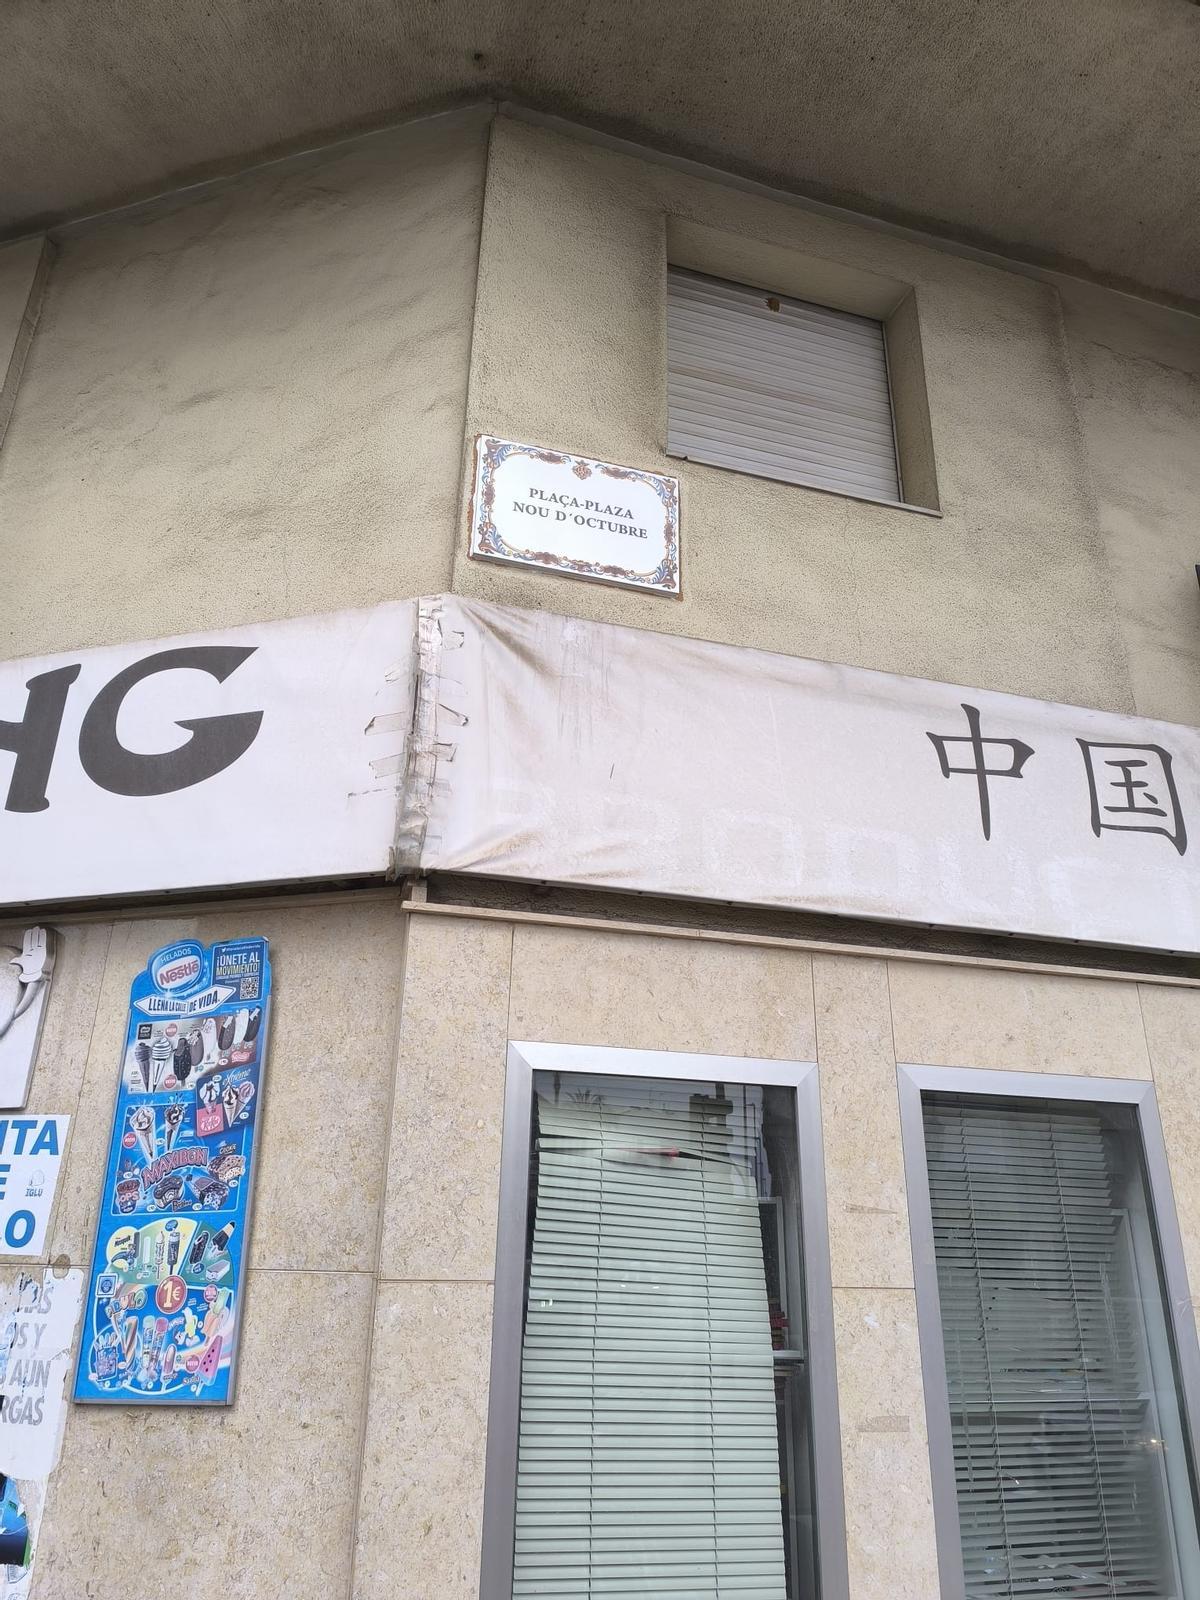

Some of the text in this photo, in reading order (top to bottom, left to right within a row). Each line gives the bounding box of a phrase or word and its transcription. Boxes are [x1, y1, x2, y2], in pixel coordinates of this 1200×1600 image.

[513, 501, 550, 518] NOU
[529, 487, 634, 520] PLAÇA-PLAZA
[926, 703, 1187, 857] 中国
[160, 948, 192, 964] HELADOS
[249, 951, 261, 964] AL
[148, 998, 169, 1011] LLENA
[189, 1000, 198, 1013] DE
[0, 1119, 59, 1156] TA
[141, 1147, 209, 1191] MAXIBON
[24, 1188, 44, 1198] IGLU
[163, 1280, 181, 1308] 1€
